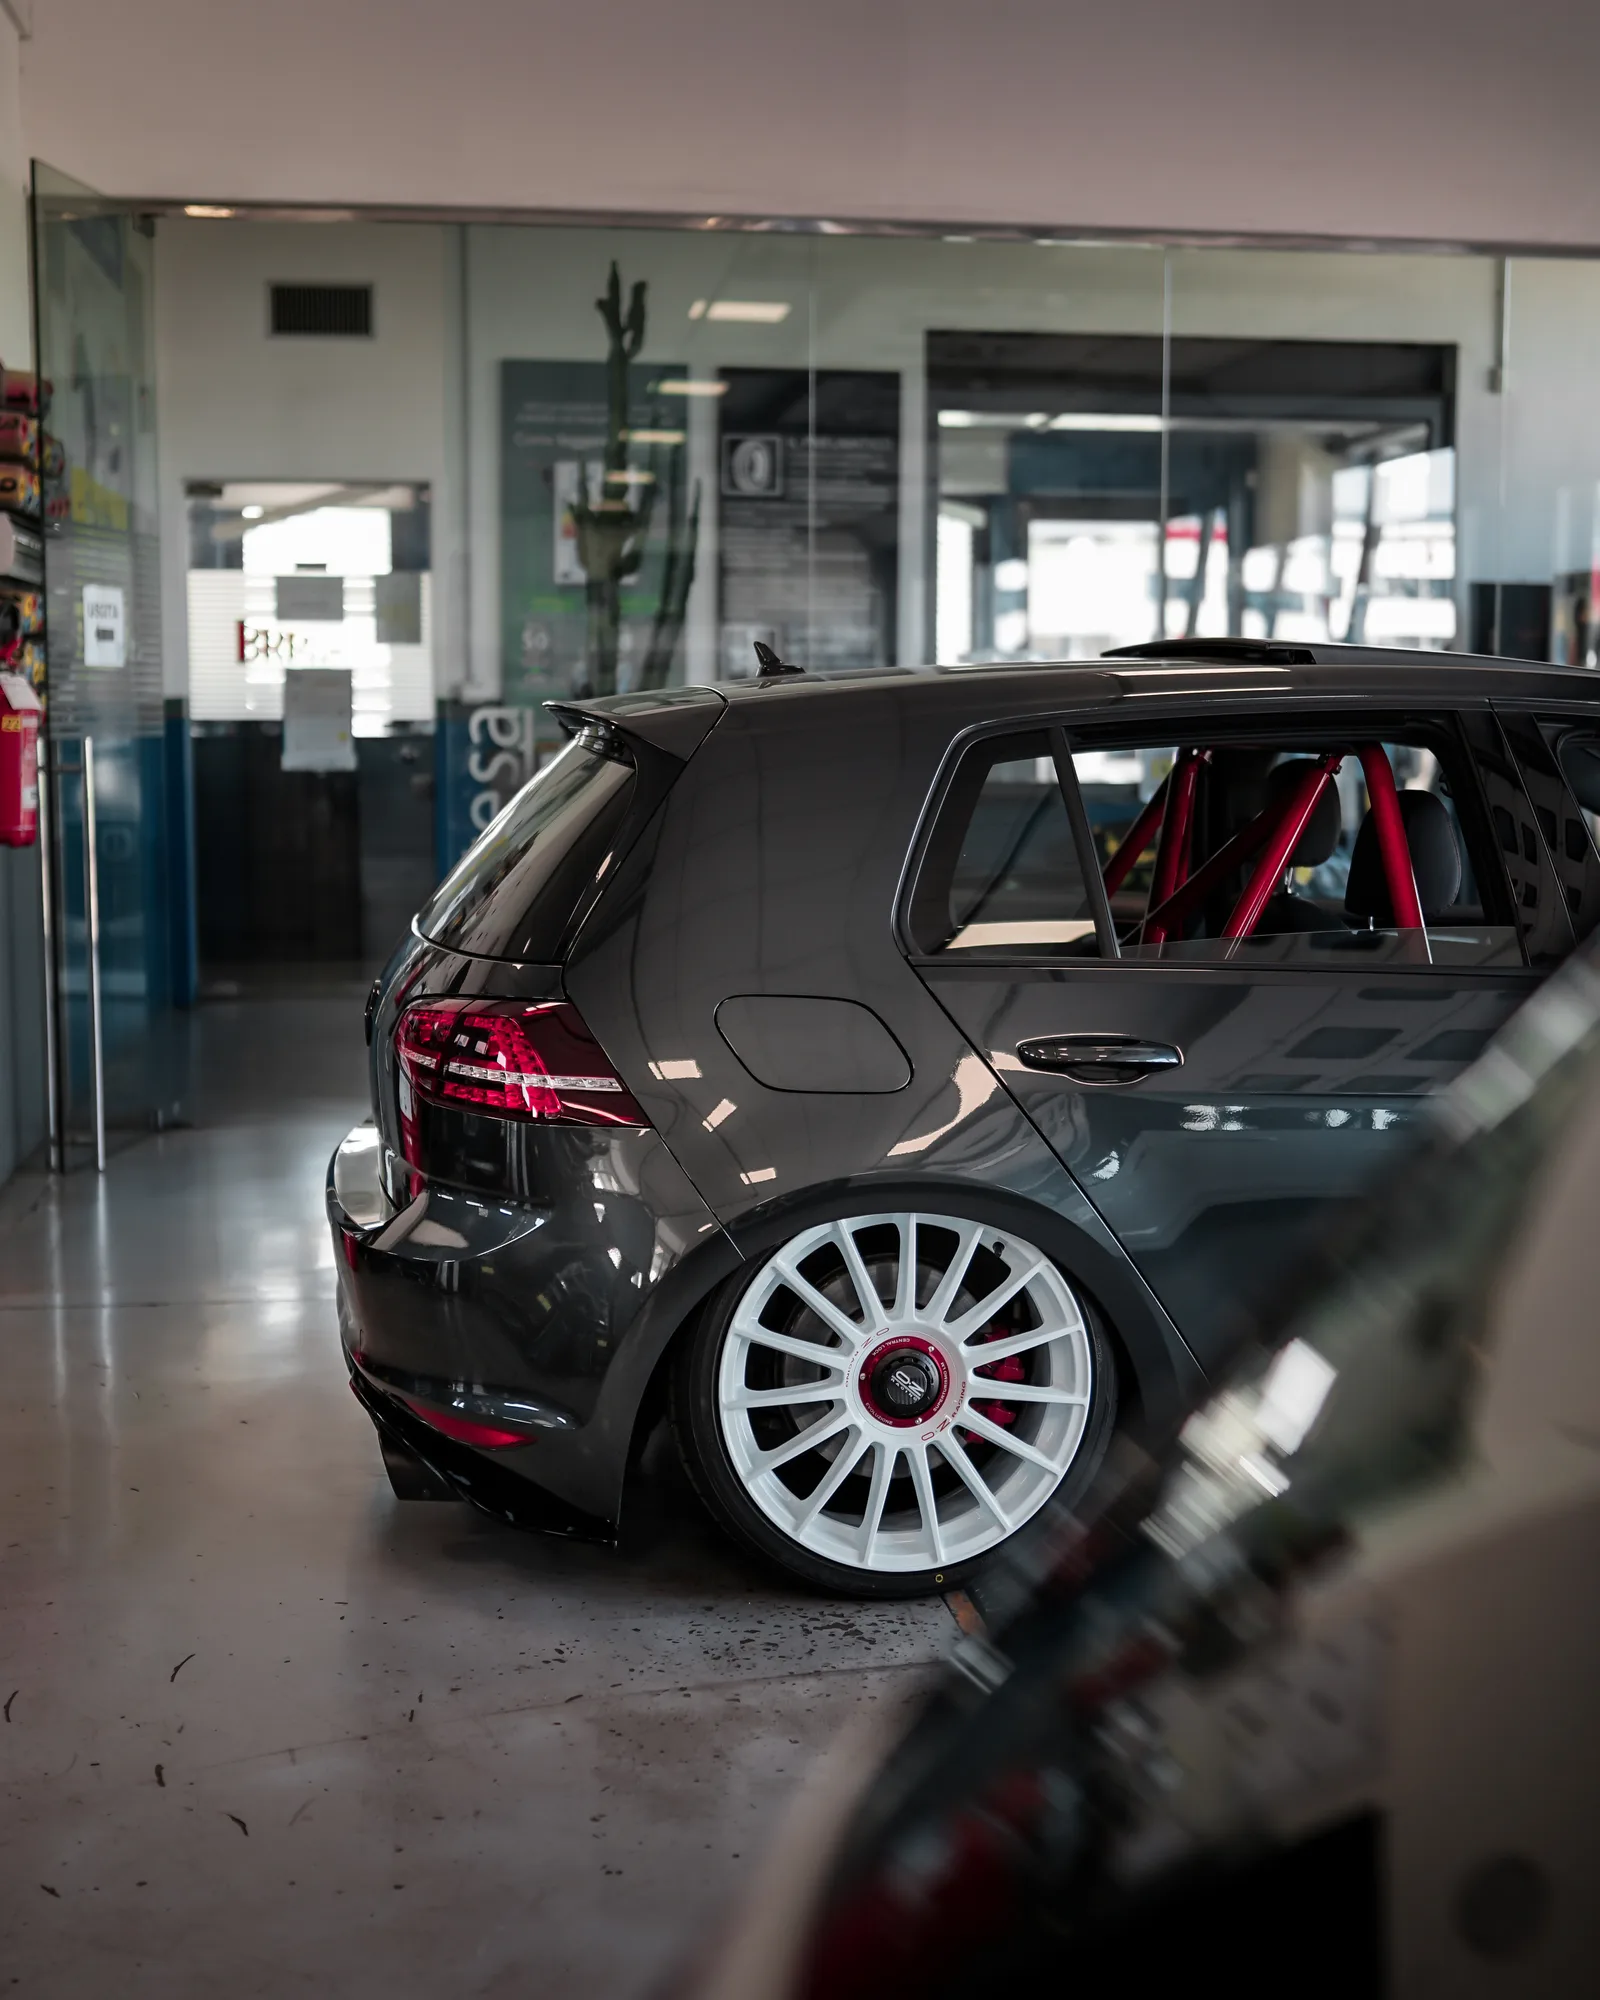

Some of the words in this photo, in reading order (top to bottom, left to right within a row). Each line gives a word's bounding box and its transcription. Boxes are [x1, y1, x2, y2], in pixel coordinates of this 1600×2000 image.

[885, 1337, 911, 1347] CENTRAL
[871, 1344, 886, 1357] LOCK
[951, 1381, 967, 1418] RACING
